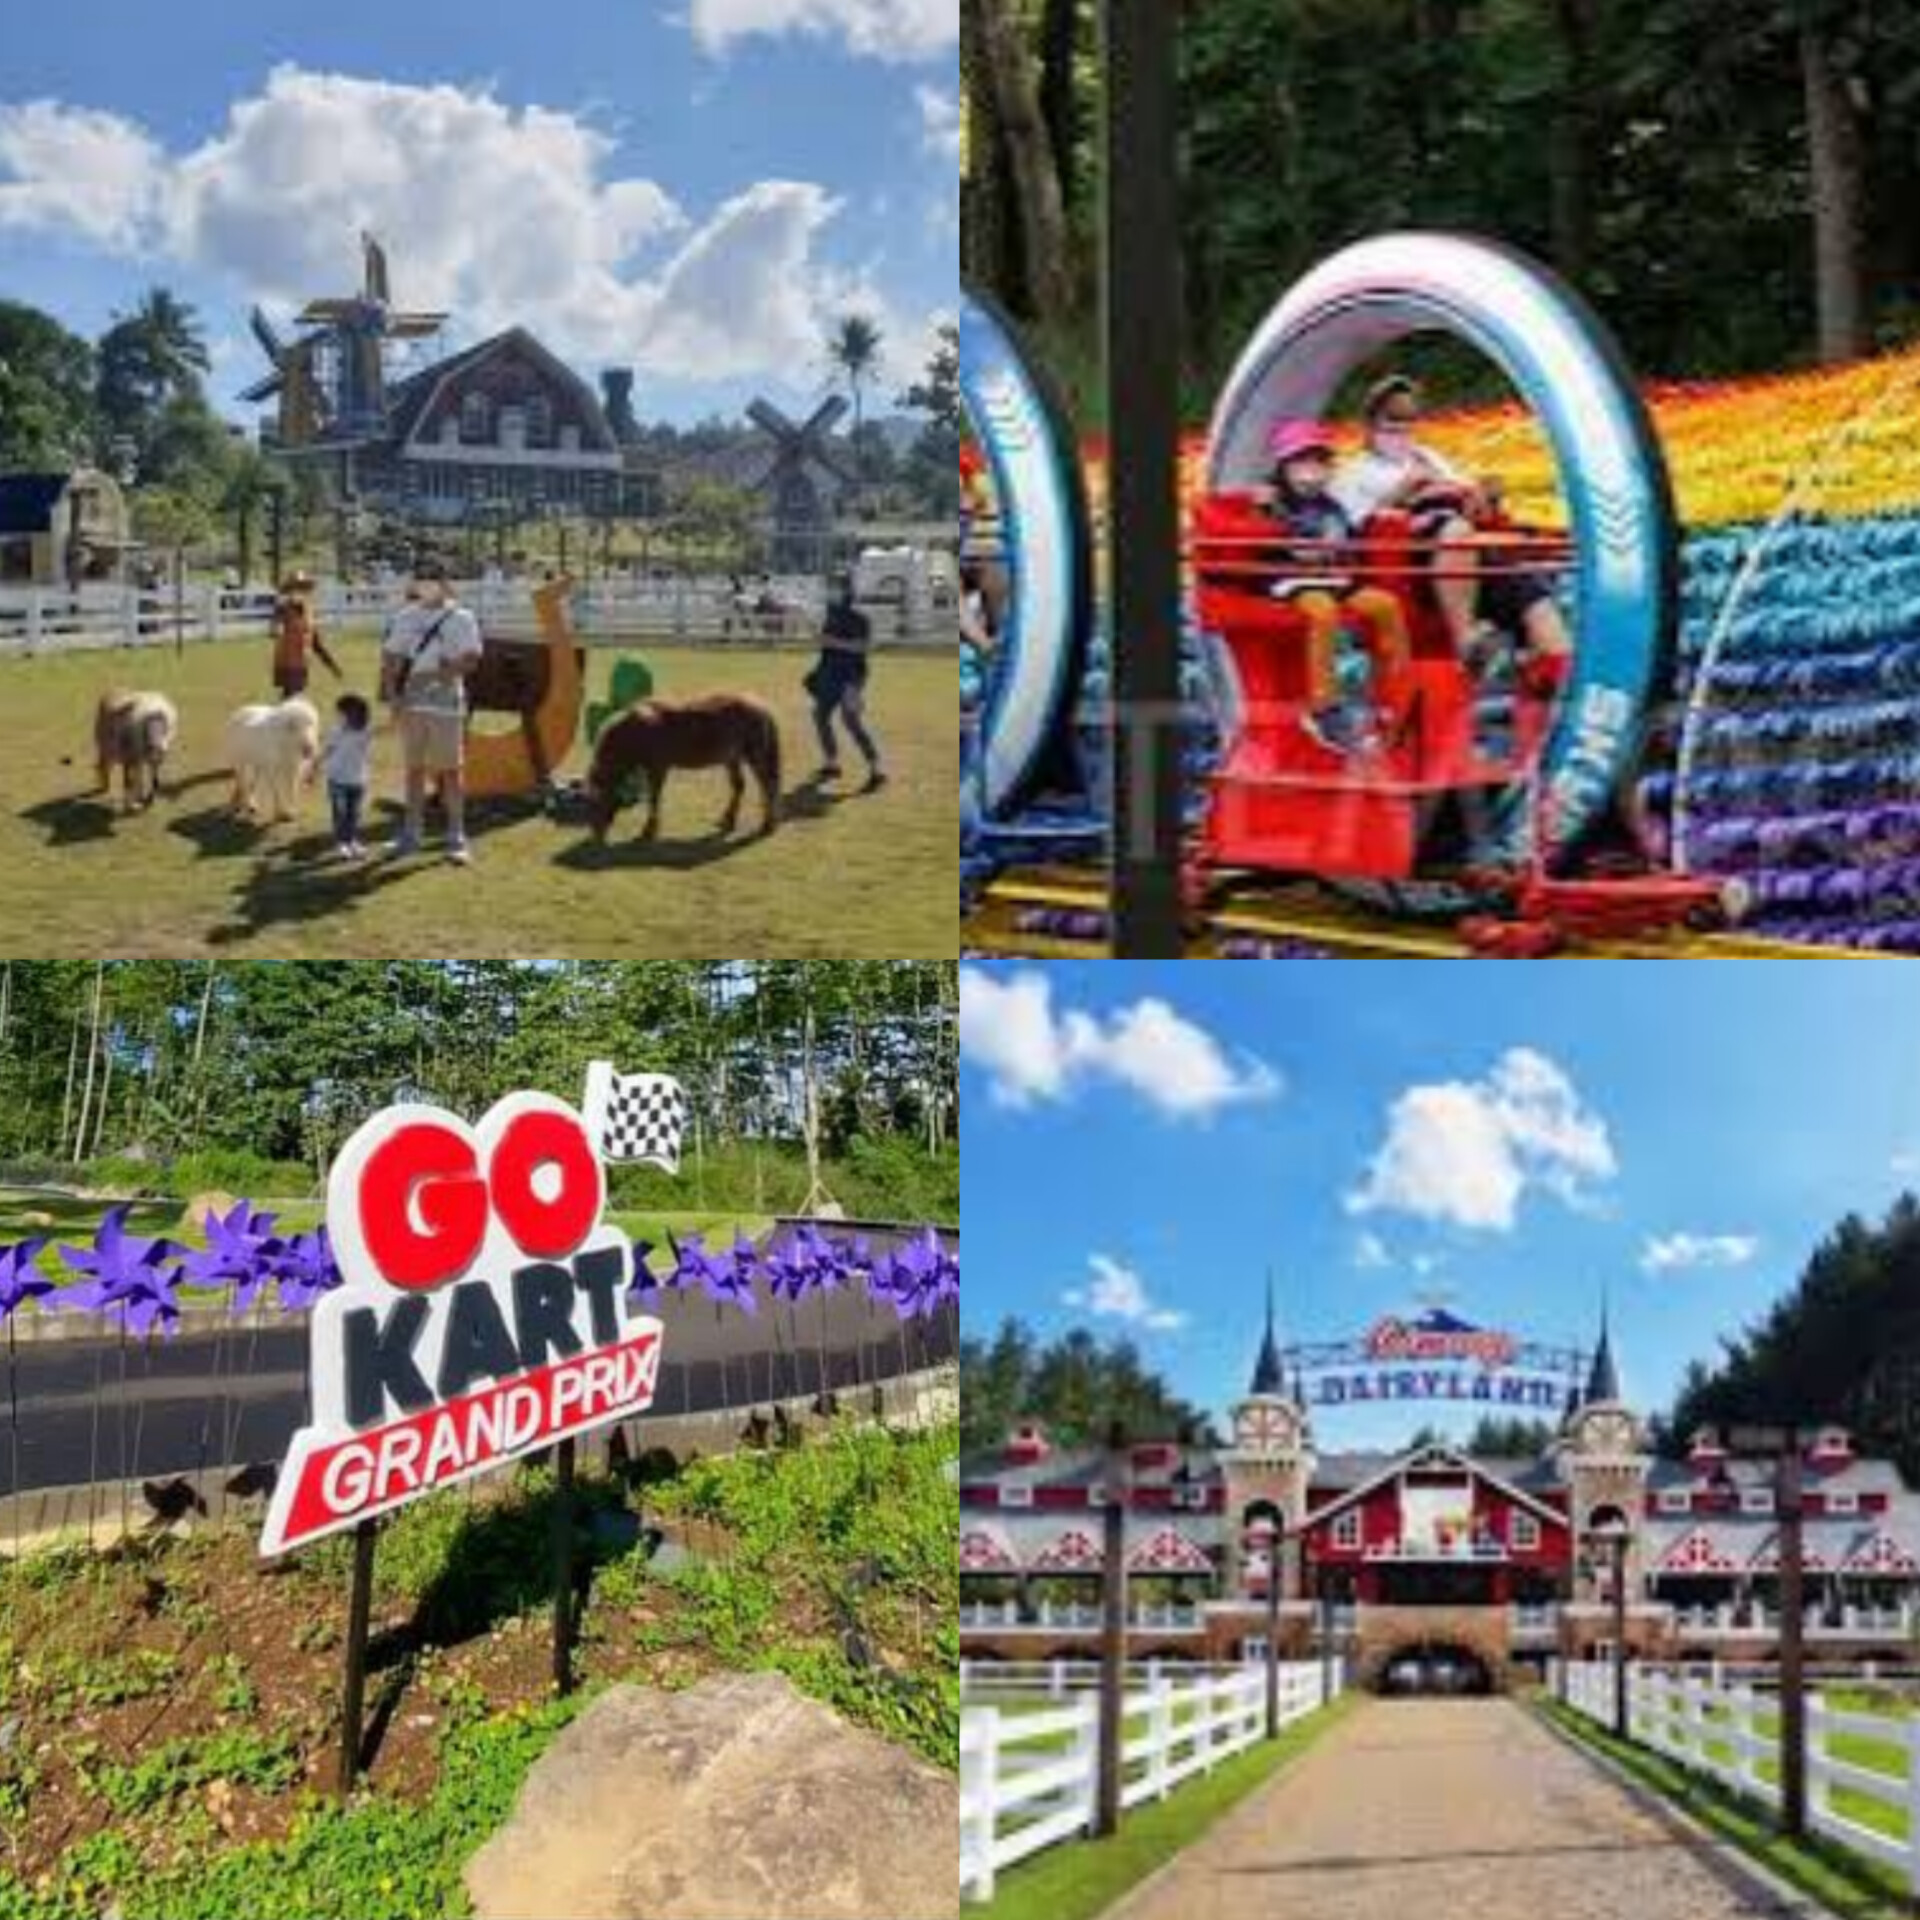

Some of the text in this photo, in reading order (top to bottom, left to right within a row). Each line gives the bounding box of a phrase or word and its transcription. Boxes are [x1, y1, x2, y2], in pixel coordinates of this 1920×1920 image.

[358, 1110, 601, 1290] GO
[342, 1246, 625, 1428] KART
[322, 1346, 656, 1513] GRAND PRIX
